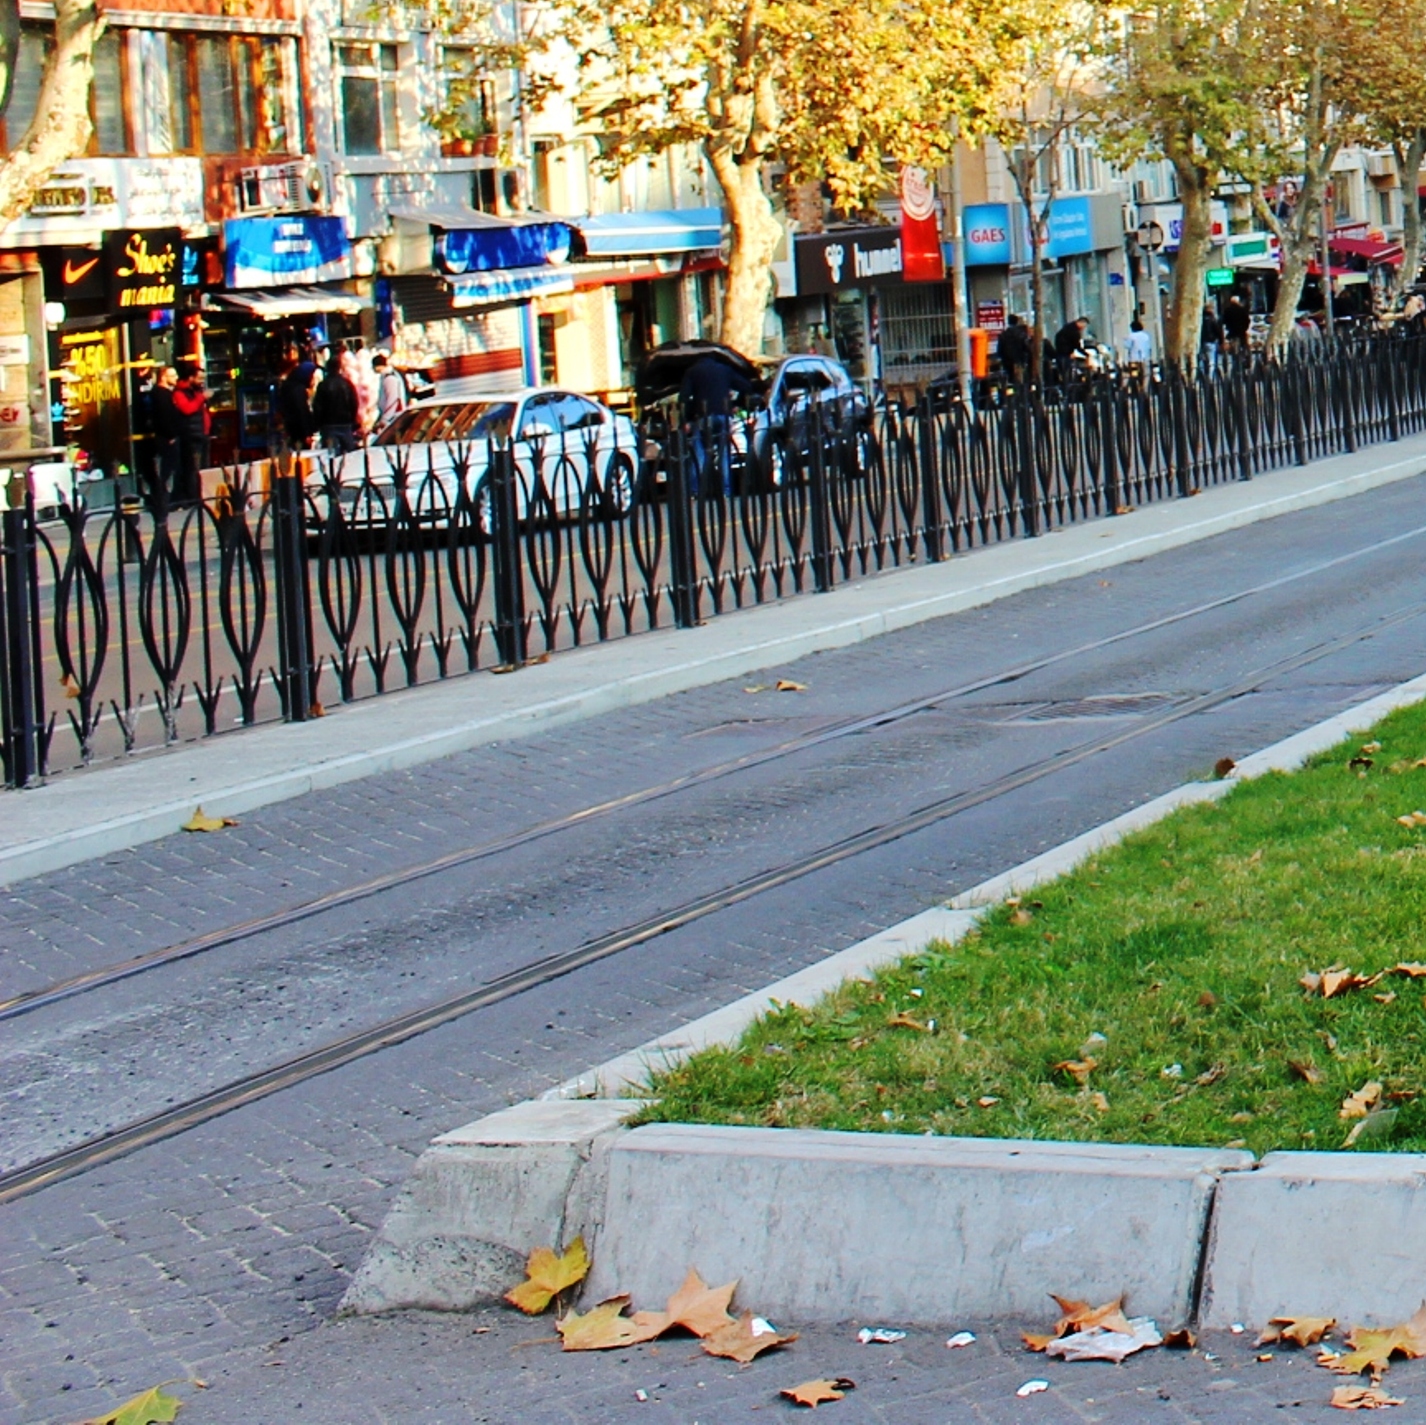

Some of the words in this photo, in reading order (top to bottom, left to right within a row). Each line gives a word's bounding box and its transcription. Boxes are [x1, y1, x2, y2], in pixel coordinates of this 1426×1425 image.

[971, 228, 1005, 243] GAES
[120, 276, 175, 307] mania
[70, 344, 106, 377] %50
